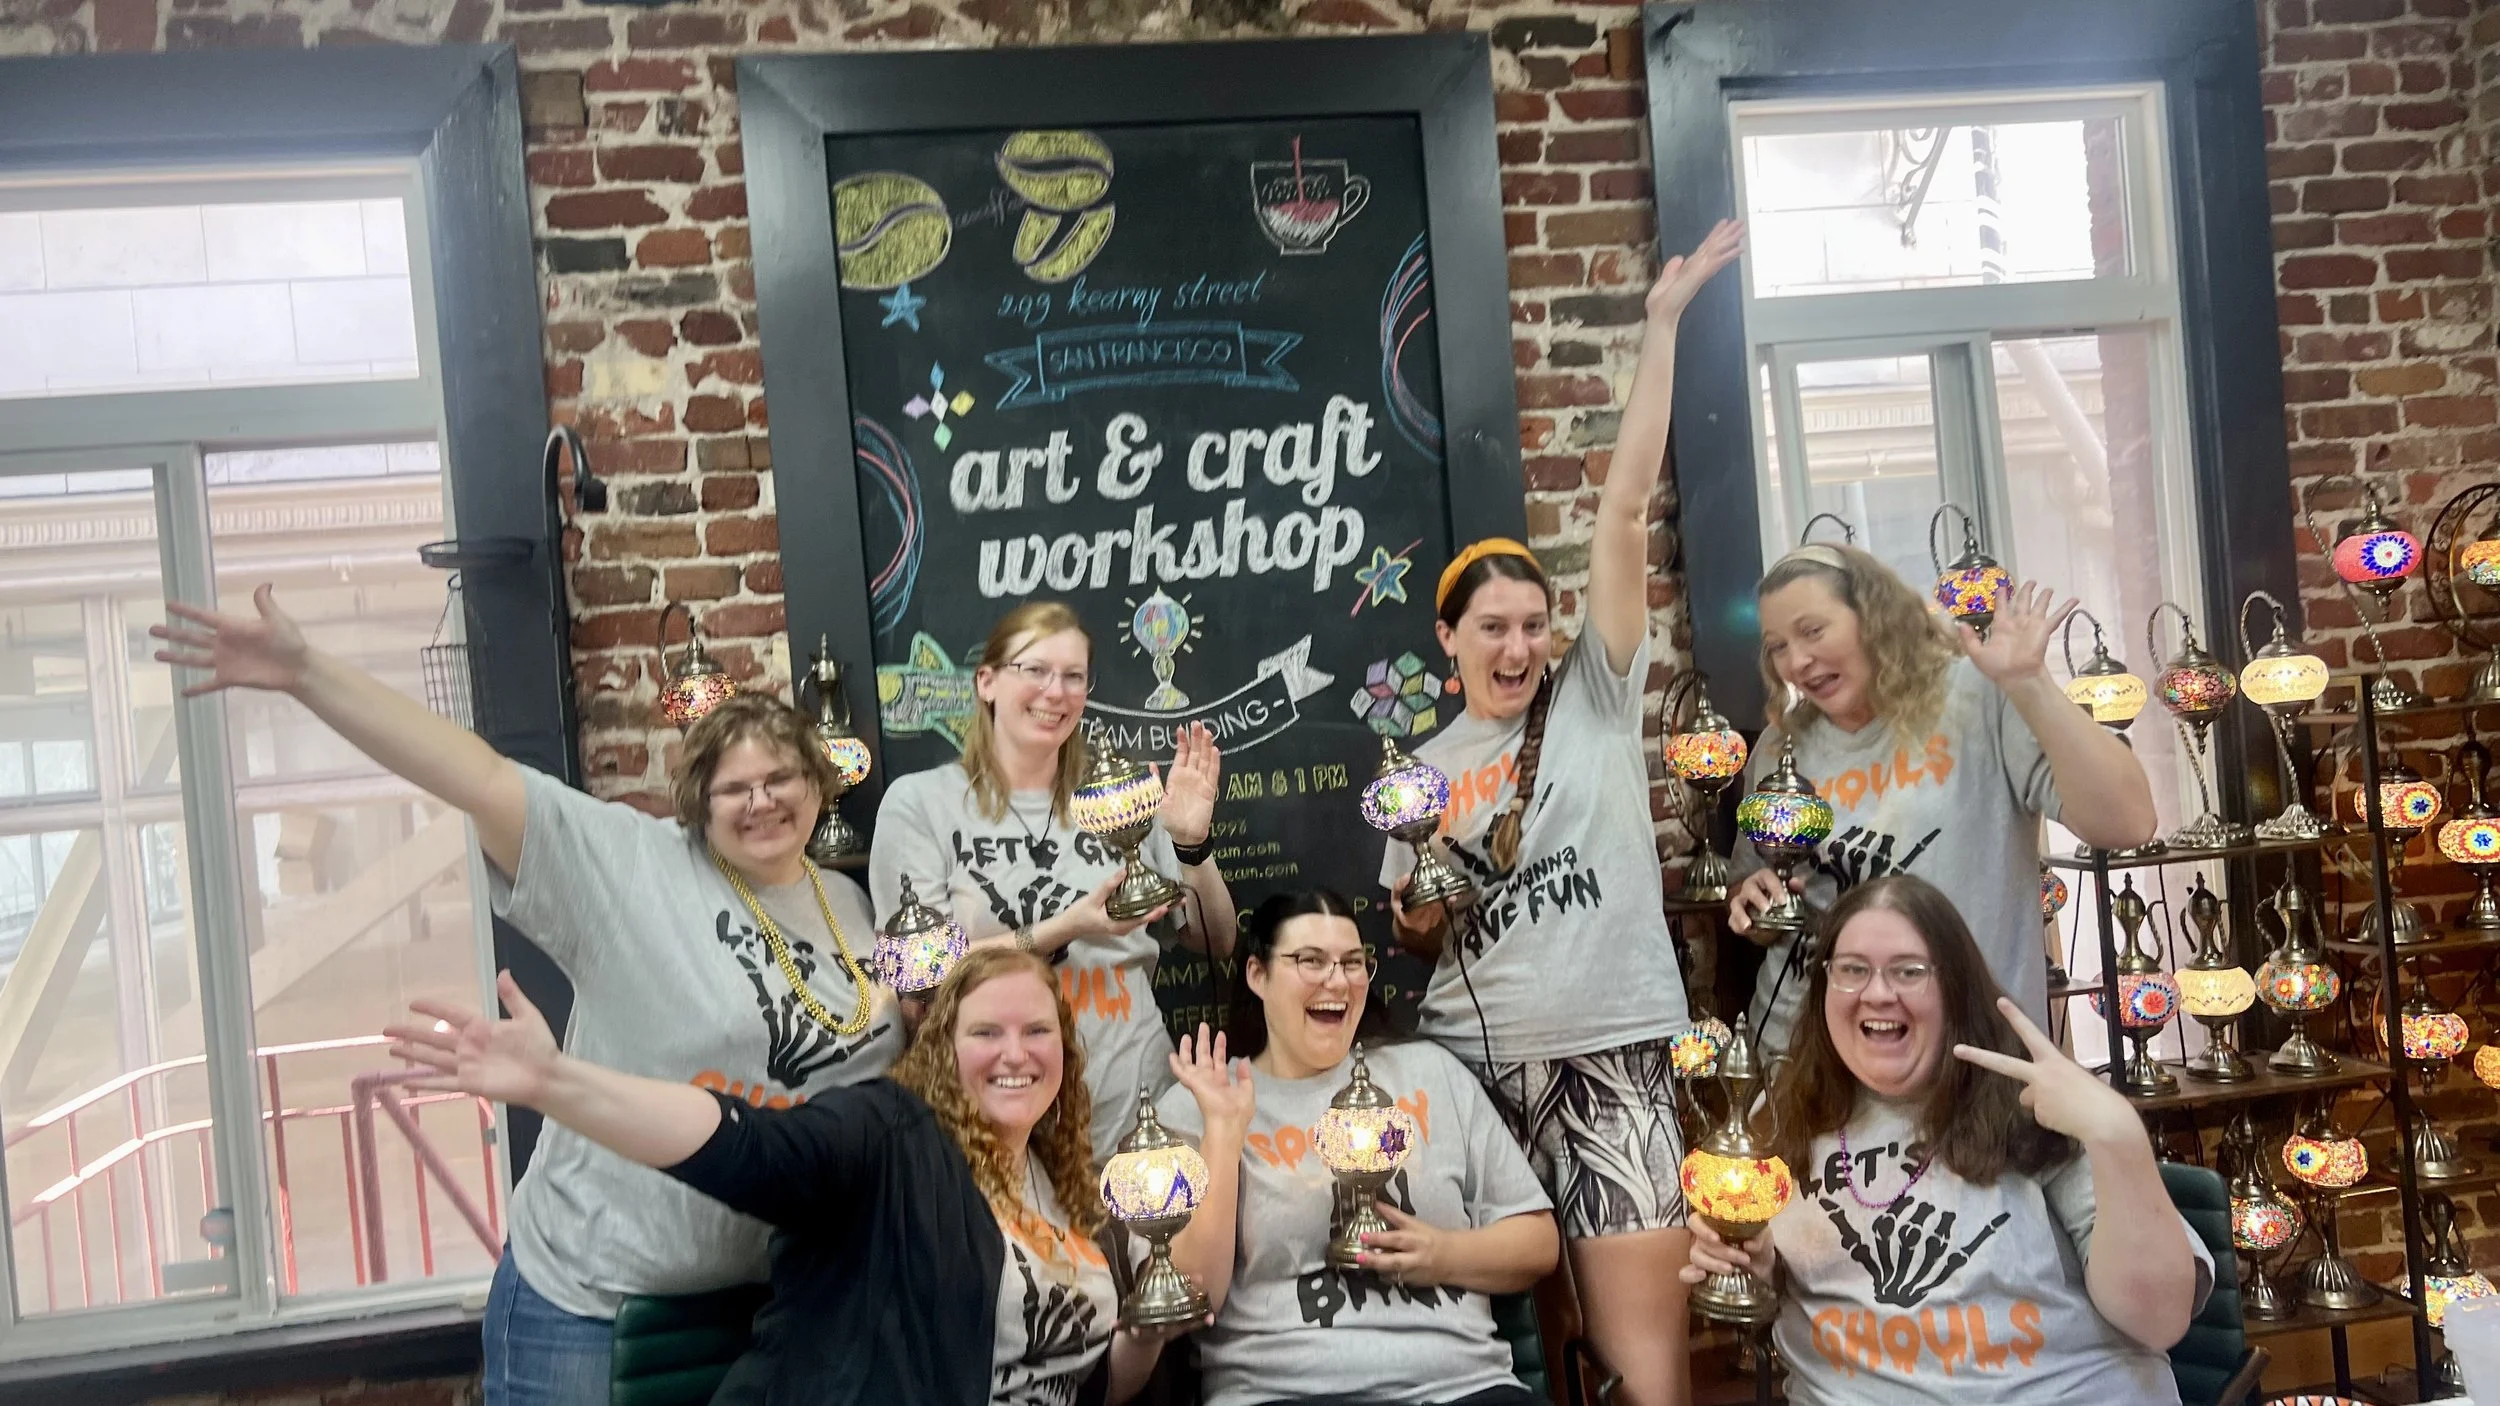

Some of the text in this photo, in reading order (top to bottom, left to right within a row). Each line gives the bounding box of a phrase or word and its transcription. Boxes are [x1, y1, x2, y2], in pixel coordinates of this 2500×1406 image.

[1173, 267, 1267, 311] street
[949, 394, 1383, 514] art & craft
[976, 497, 1367, 600] workshop
[1226, 770, 1263, 801] AM
[1312, 762, 1351, 793] PM
[1528, 867, 1602, 924] FUN
[1811, 1302, 2045, 1379] GHOULS
